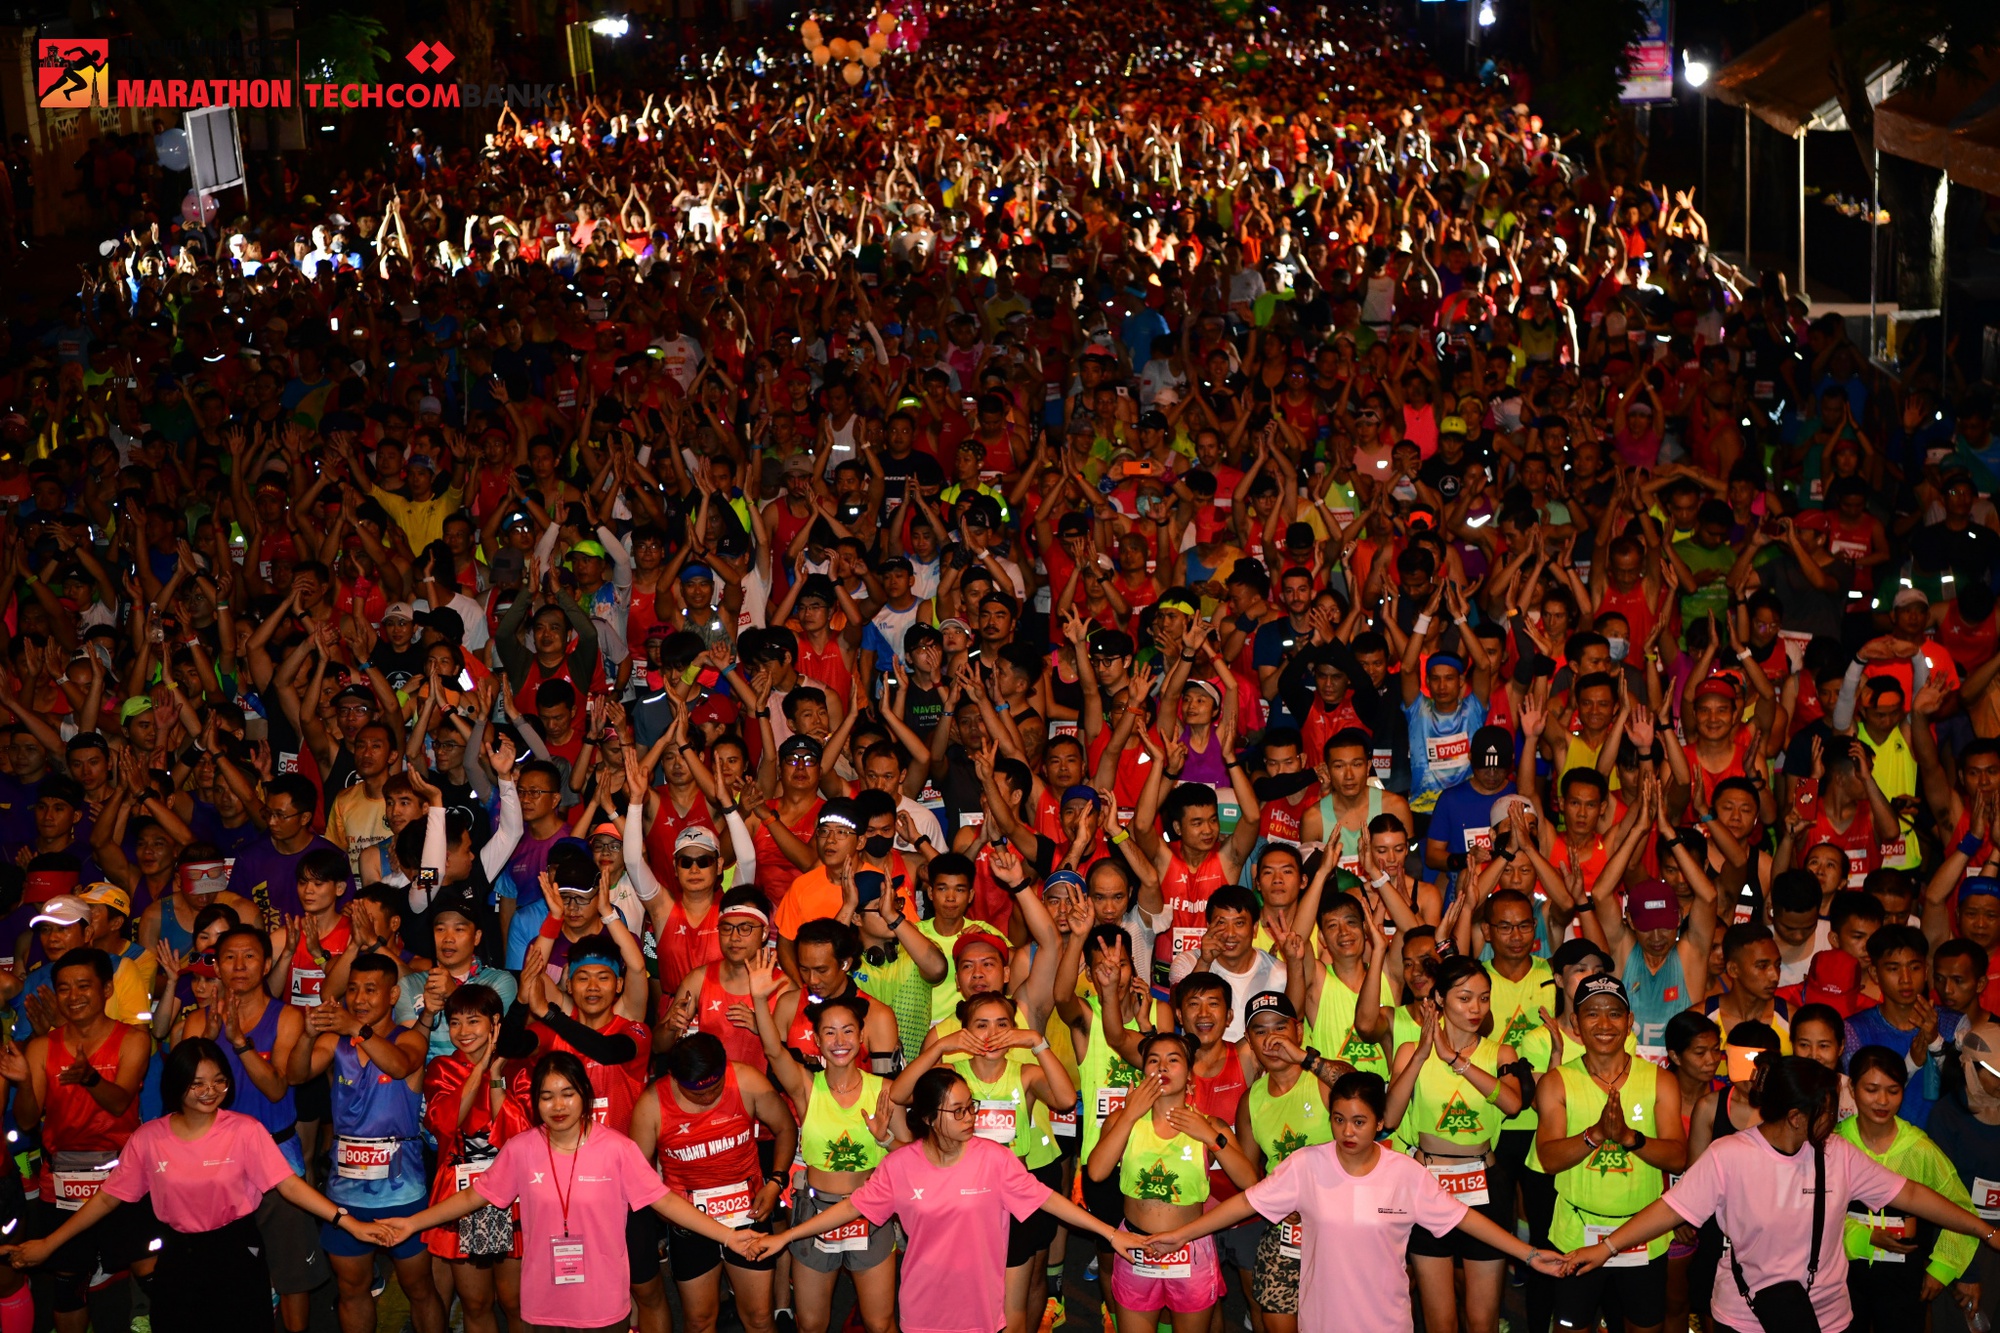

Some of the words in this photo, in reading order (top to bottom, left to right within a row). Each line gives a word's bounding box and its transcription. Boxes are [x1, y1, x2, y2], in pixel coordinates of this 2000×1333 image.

[912, 704, 942, 714] NAVER
[1428, 747, 1436, 758] E
[1438, 741, 1467, 757] 97067
[279, 761, 286, 770] C
[1851, 861, 1863, 872] 51
[1174, 938, 1182, 949] C
[292, 979, 300, 991] A
[1348, 1043, 1369, 1056] 365
[1118, 1063, 1129, 1071] FIT
[1114, 1071, 1132, 1083] 365
[1098, 1099, 1106, 1112] E
[1450, 1108, 1466, 1116] RUN
[1447, 1115, 1471, 1128] 365
[708, 1136, 735, 1156] NHÂN
[1285, 1140, 1296, 1150] FIT
[346, 1149, 387, 1164] 90870
[1599, 1152, 1623, 1166] 365
[1150, 1175, 1165, 1183] FIT
[1440, 1174, 1486, 1192] 21152
[65, 1184, 101, 1198] 9067
[1148, 1183, 1168, 1195] 365
[707, 1195, 749, 1216] 33023
[1282, 1225, 1291, 1241] E
